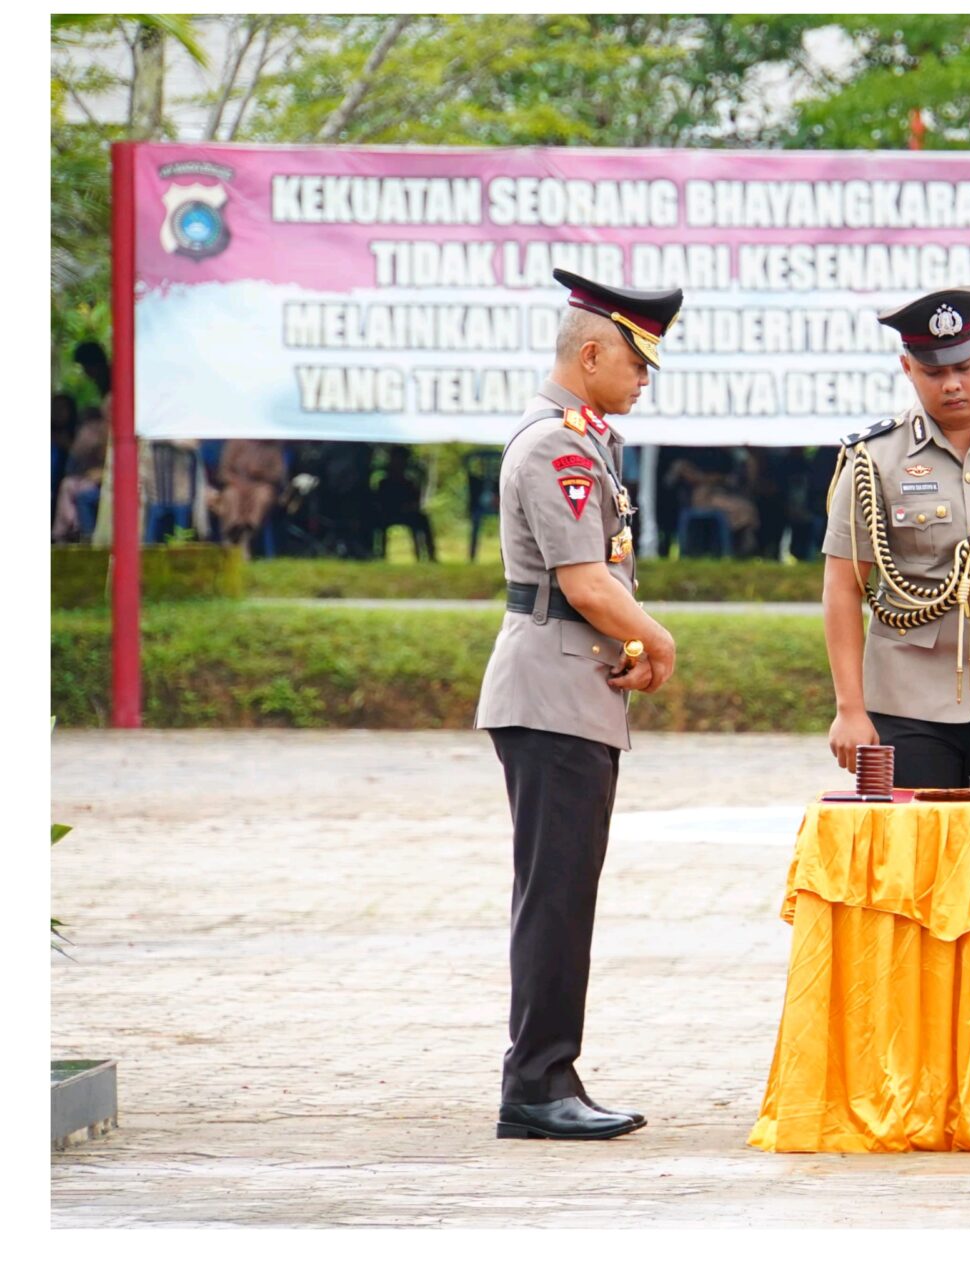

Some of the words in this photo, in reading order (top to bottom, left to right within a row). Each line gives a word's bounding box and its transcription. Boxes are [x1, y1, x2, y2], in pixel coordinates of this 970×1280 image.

[272, 175, 483, 225] KEKUATAN
[488, 176, 678, 228] SEORANG
[369, 240, 496, 290] TIDAK
[502, 240, 624, 290] LAHIR
[631, 242, 731, 291] DARI
[284, 302, 521, 354] MELAINKAN
[294, 363, 405, 414] YANG
[411, 366, 537, 416] TELAH
[784, 369, 918, 418] DENGA
